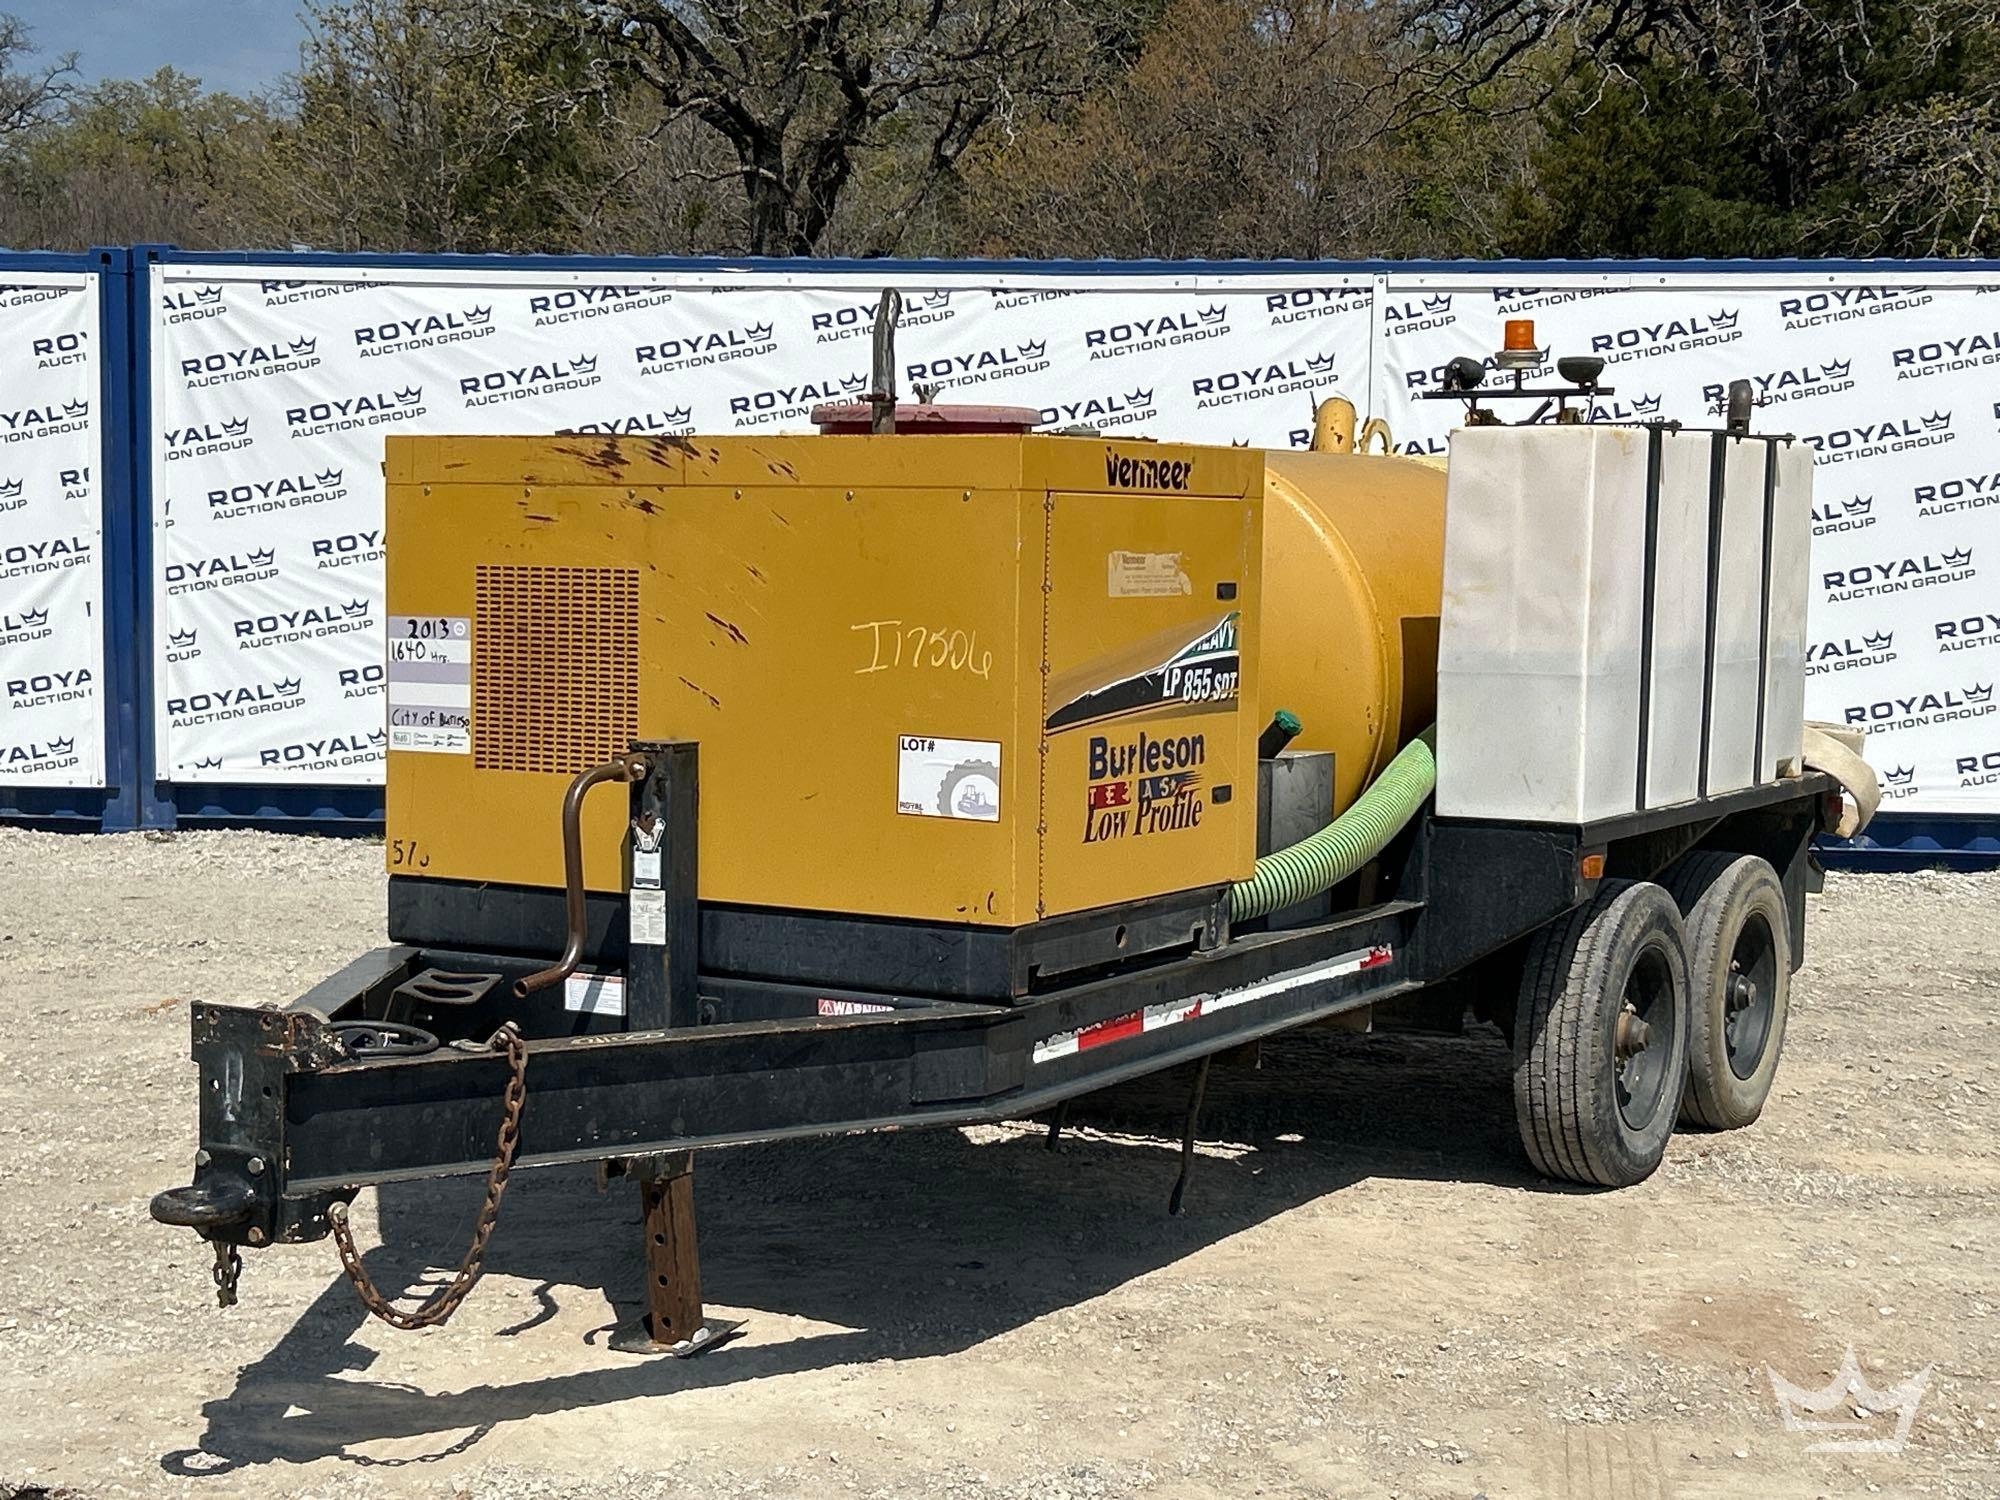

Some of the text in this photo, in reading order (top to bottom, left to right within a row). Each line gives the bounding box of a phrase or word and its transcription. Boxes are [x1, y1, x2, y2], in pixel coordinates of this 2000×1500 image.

[11, 288, 68, 307] GROUP
[266, 286, 340, 306] AUCTION
[536, 294, 672, 326] AUCTION GROUP
[1497, 292, 1576, 314] AUCTION
[170, 306, 226, 324] GROUP
[354, 312, 464, 346] ROYAL
[1272, 302, 1348, 326] AUCTION
[1394, 316, 1456, 334] GROUP
[1784, 296, 1932, 330] AUCTION GROUP
[360, 326, 496, 358] AUCTION GROUP
[636, 330, 746, 364] ROYAL
[1086, 314, 1198, 348] ROYAL
[1090, 326, 1230, 360] AUCTION GROUP
[1592, 318, 1708, 352] ROYAL
[1680, 330, 1742, 350] GROUP
[182, 344, 290, 376] ROYAL
[188, 358, 320, 390] AUCTION GROUP
[640, 344, 778, 376] AUCTION GROUP
[906, 348, 1018, 382] ROYAL
[990, 360, 1050, 380] GROUP
[1898, 358, 1978, 380] AUCTION
[460, 362, 570, 396] ROYAL
[466, 376, 600, 408] AUCTION GROUP
[1192, 362, 1306, 396] ROYAL
[1198, 374, 1338, 410] AUCTION GROUP
[1702, 367, 1821, 402] RYAL
[1792, 380, 1854, 400] GROUP
[286, 394, 396, 426] ROYAL
[730, 382, 840, 414] ROYAL
[292, 408, 426, 438] AUCTION GROUP
[736, 406, 810, 426] AUCTION
[1096, 410, 1156, 428] GROUP
[196, 438, 254, 456] GROUP
[1892, 432, 1954, 452] GROUP
[1106, 448, 1191, 490] Vermeer
[208, 476, 316, 508] ROYAL
[214, 490, 346, 520] AUCTION GROUP
[1812, 518, 1876, 536] GROUP
[0, 536, 90, 564] OYAL
[312, 530, 386, 557] ROY
[222, 568, 278, 586] GROUP
[1822, 556, 1942, 590] ROYAL
[1828, 570, 1976, 602] AUCTION GROUP
[234, 606, 342, 638] ROYAL
[240, 620, 374, 650] AUCTION GROUP
[407, 618, 449, 639] 2013
[1834, 652, 1896, 670] GROUP
[12, 690, 84, 710] AUCTION
[168, 684, 274, 716] ROYAL
[1162, 667, 1181, 697] LP
[1183, 667, 1213, 702] 855
[172, 698, 306, 728] AUCTION GROUP
[1844, 690, 1964, 724] ROYAL
[1934, 704, 1996, 724] GROUP
[22, 756, 78, 774] GROUP
[260, 736, 368, 766] ROYAL
[1089, 732, 1204, 781] Burleson
[1082, 803, 1130, 844] Low
